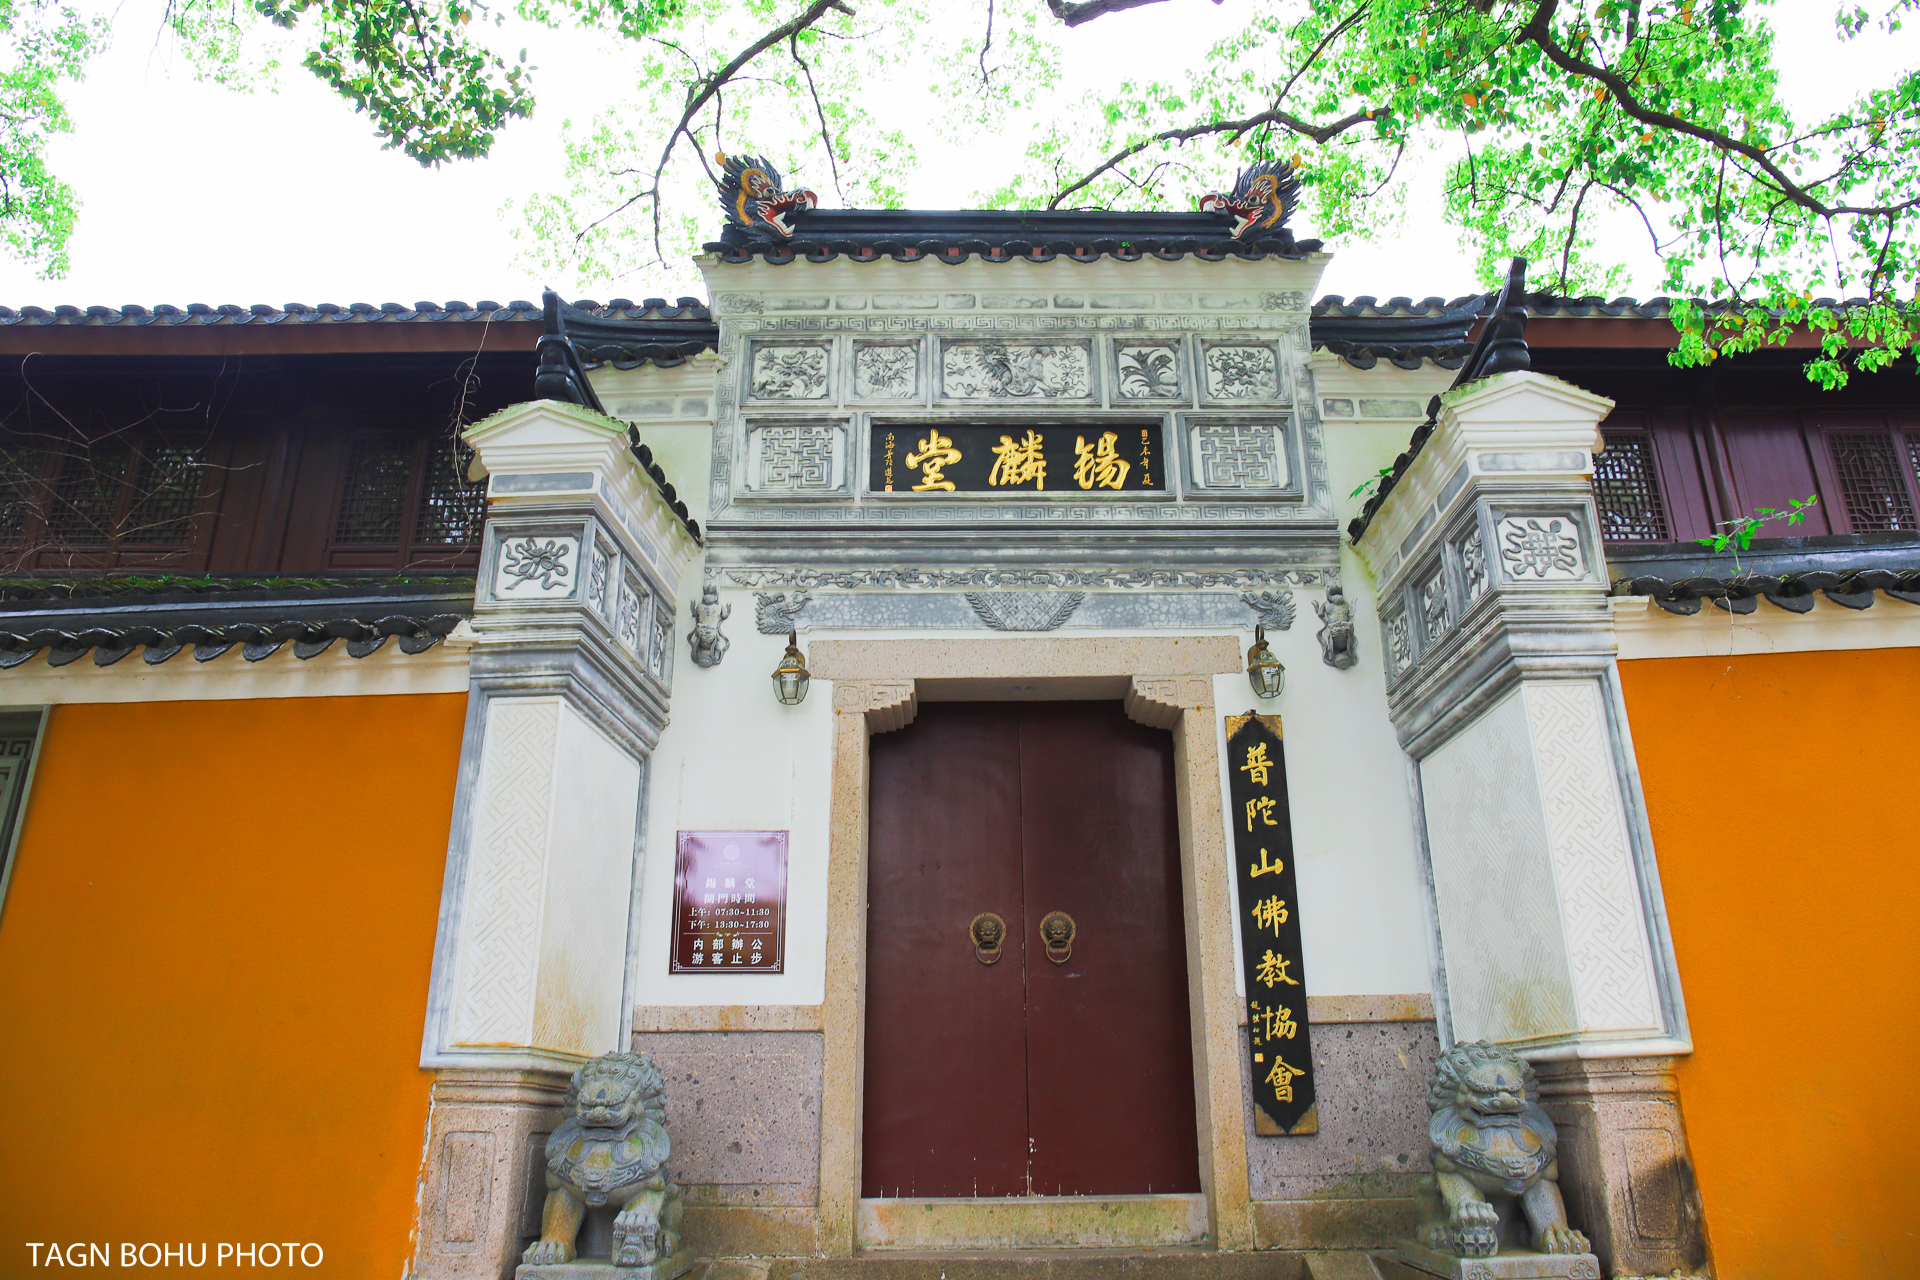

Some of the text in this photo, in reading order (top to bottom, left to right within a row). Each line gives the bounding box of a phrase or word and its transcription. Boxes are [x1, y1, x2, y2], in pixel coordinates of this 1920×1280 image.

[704, 893, 756, 905] 開門時間
[1240, 742, 1306, 1103] 普陀山佛教協會
[692, 952, 763, 965] 游客止步
